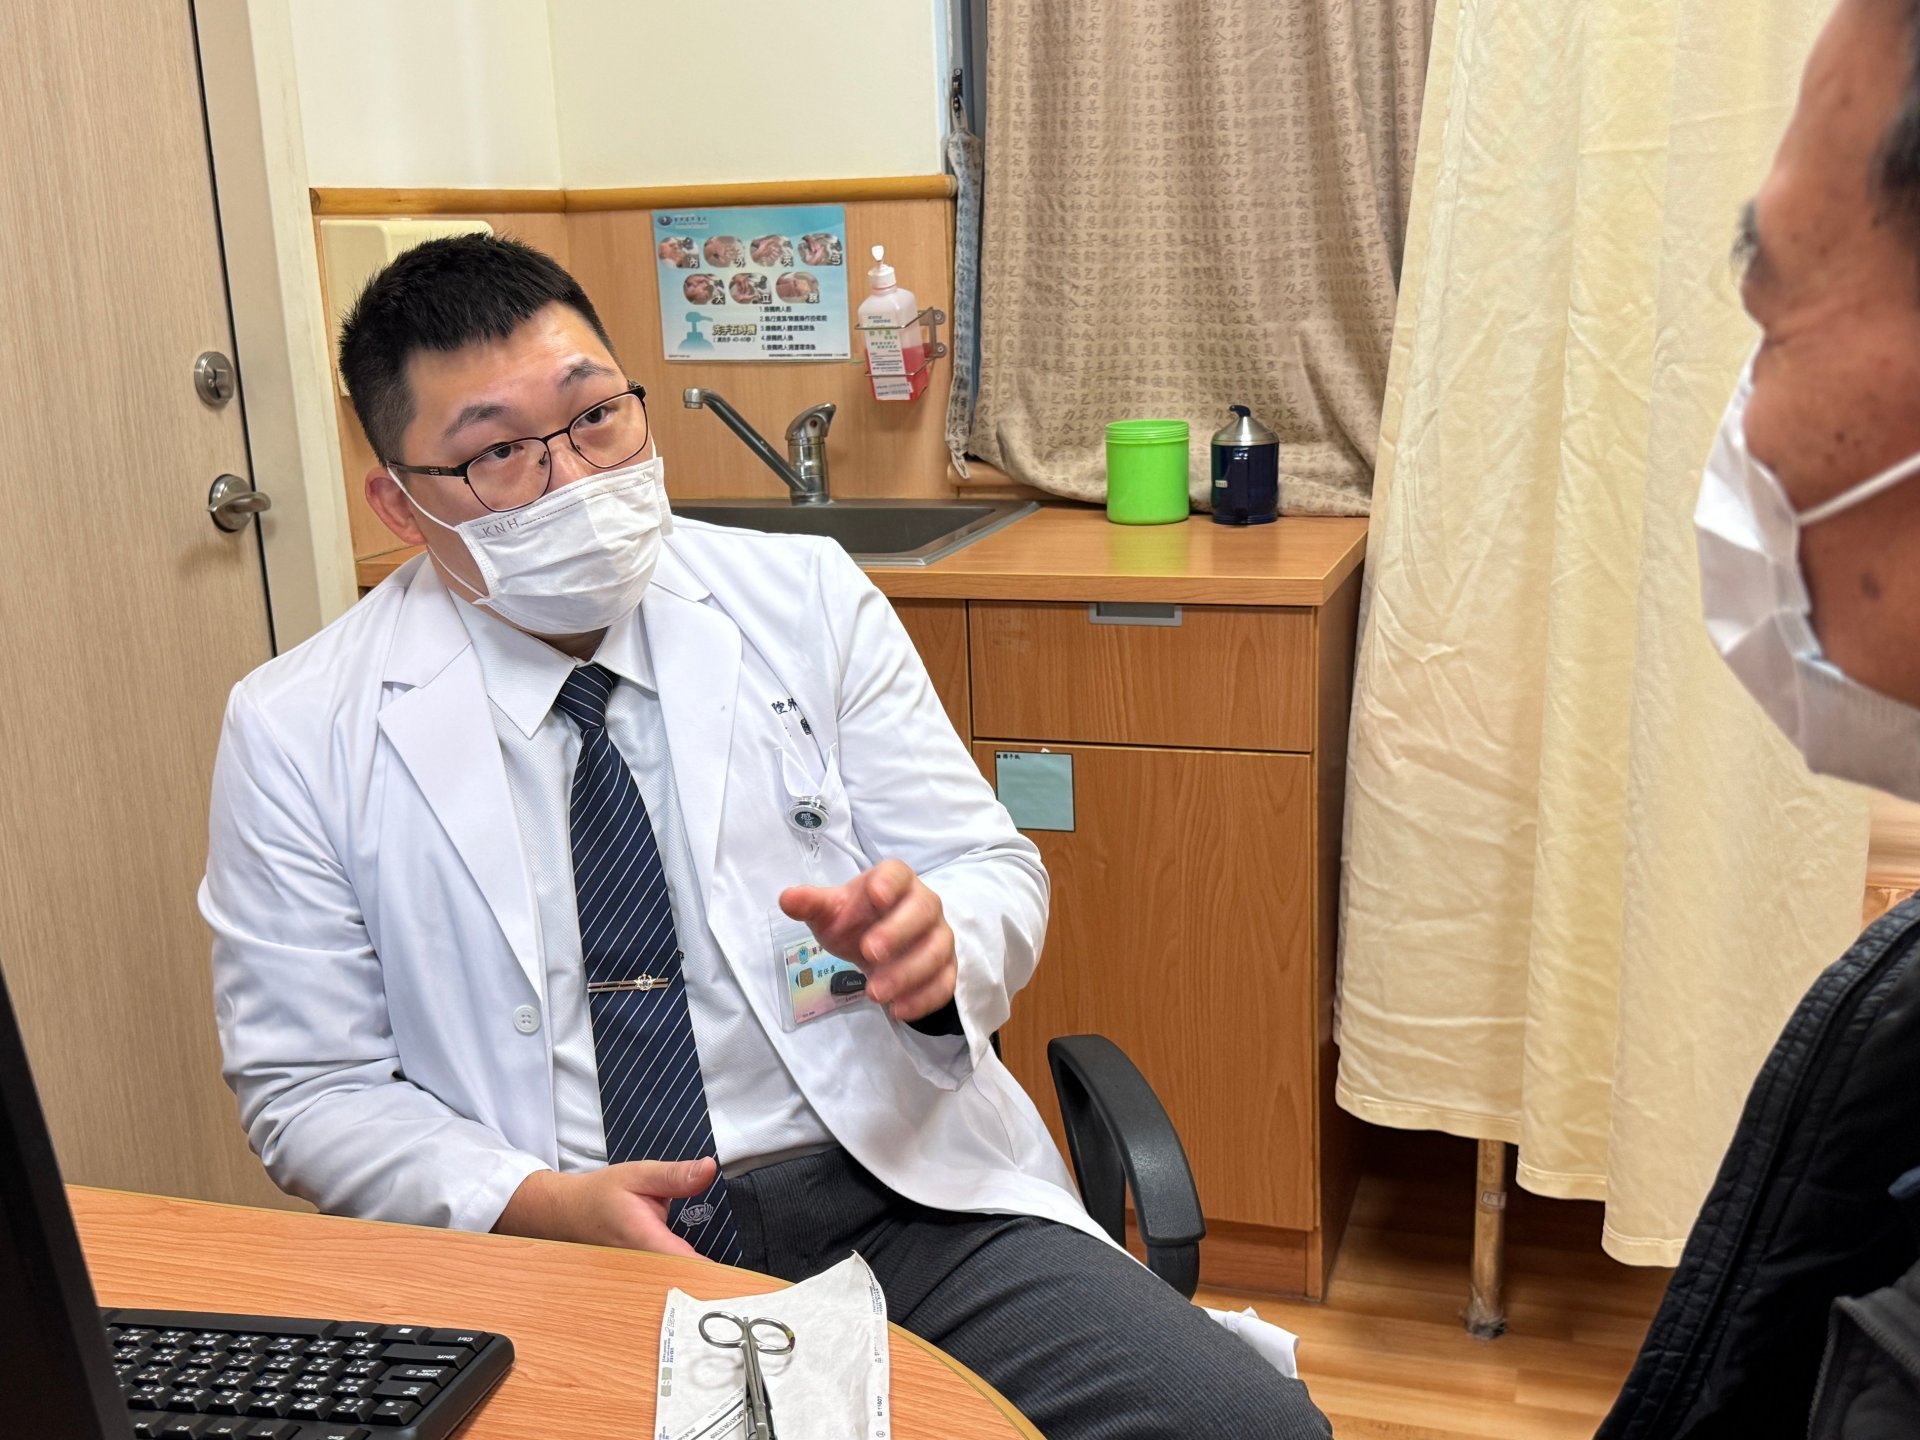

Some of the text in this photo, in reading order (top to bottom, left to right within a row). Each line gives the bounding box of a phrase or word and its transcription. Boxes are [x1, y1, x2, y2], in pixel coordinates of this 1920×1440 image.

[715, 295, 724, 303] 大
[762, 295, 771, 303] 立
[483, 518, 519, 537] KNH
